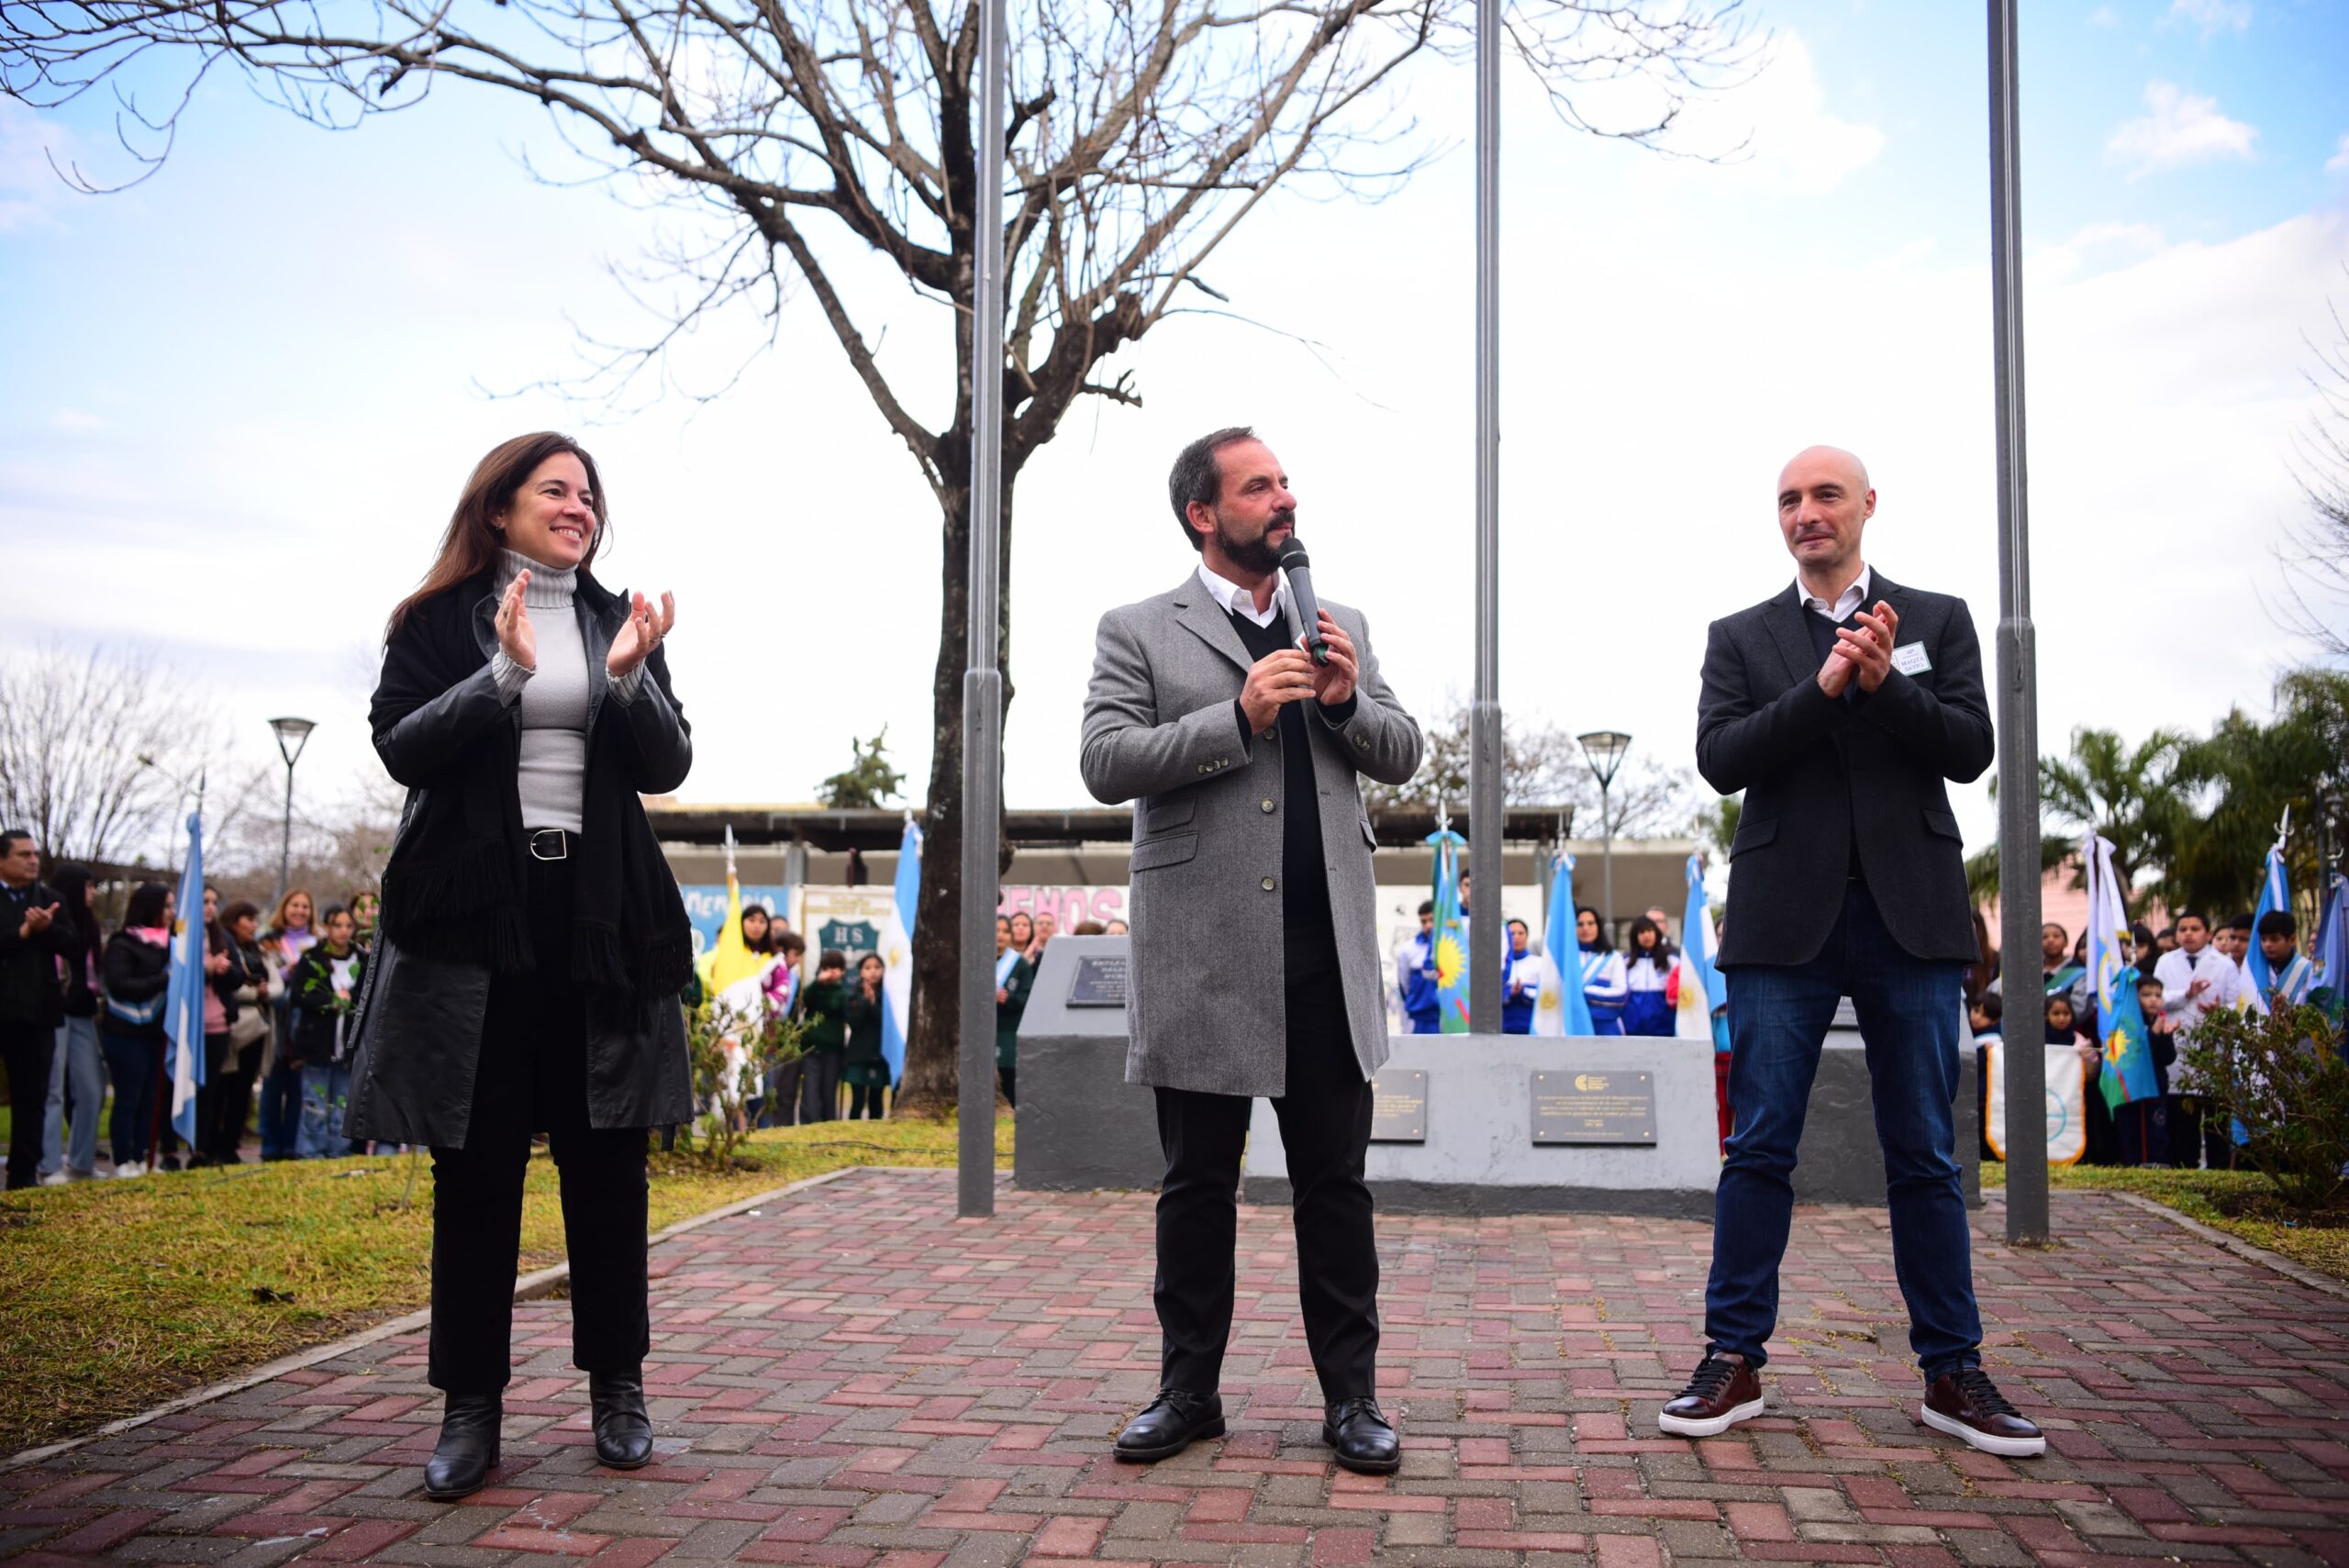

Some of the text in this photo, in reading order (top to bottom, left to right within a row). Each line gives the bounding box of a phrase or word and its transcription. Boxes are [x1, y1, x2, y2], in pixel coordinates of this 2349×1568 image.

[997, 887, 1122, 935] ENOS
[834, 927, 863, 945] H S
